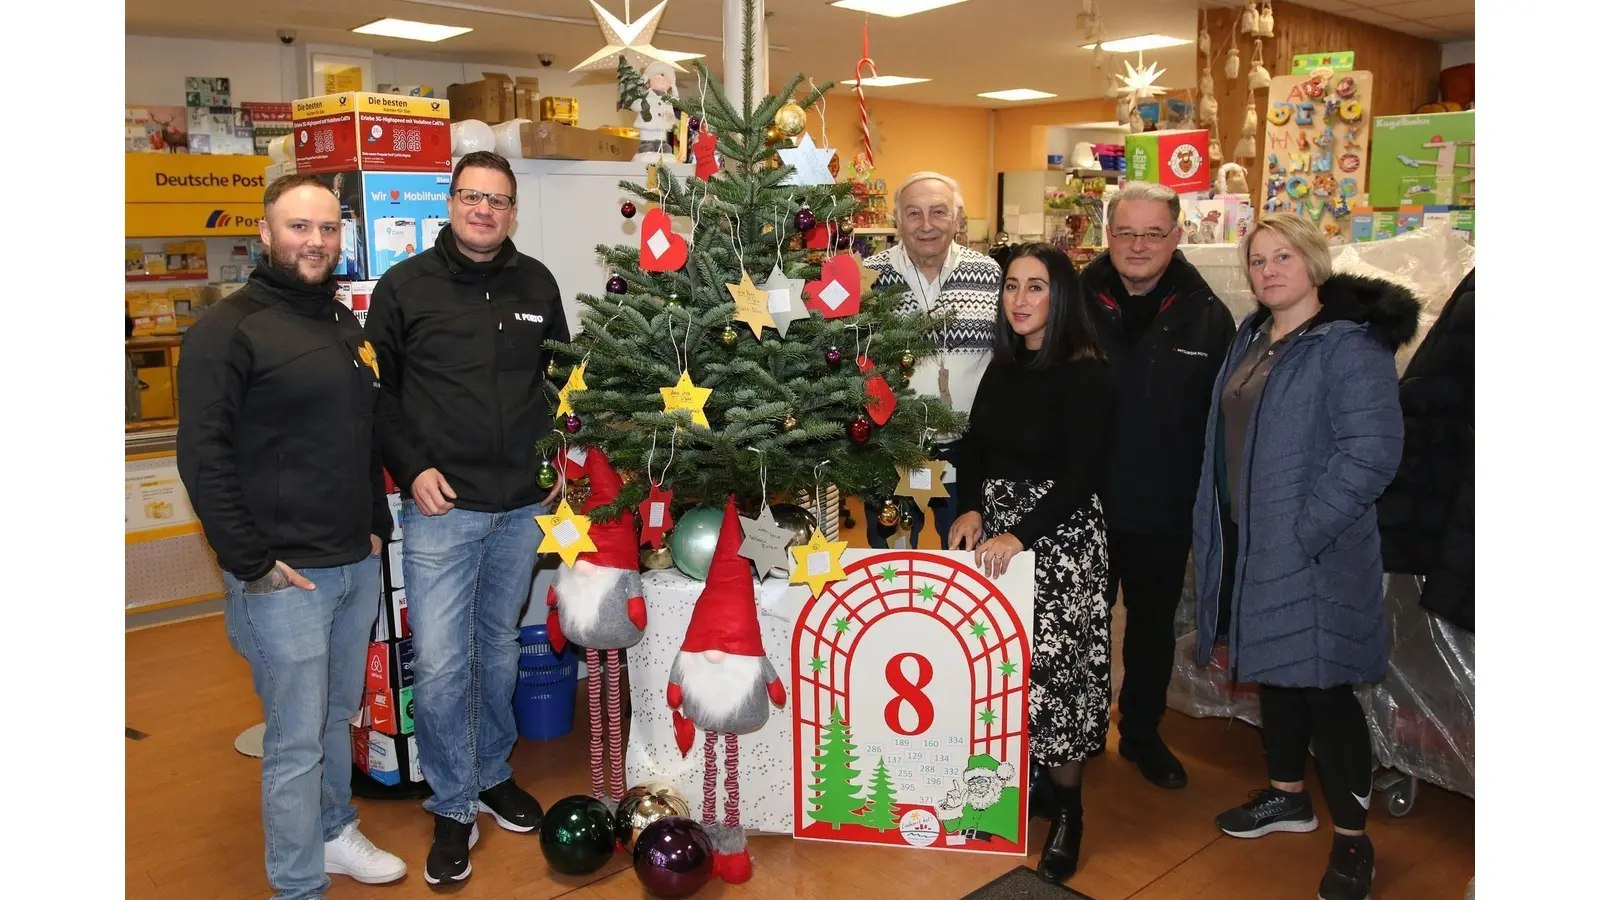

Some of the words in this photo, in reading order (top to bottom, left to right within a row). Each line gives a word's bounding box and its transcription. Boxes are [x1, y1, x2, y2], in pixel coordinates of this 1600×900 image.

[306, 102, 322, 110] besten
[368, 97, 381, 105] Die
[383, 98, 408, 107] besten
[1376, 117, 1430, 129] Kugelbahn
[393, 140, 407, 151] 20
[407, 140, 422, 152] GB
[155, 172, 229, 187] Deutsche
[232, 174, 265, 187] Post
[371, 191, 387, 201] Wir
[404, 191, 447, 201] Mobilfunk
[386, 227, 392, 235] 9
[884, 652, 935, 736] 8
[375, 694, 387, 704] NIKE
[924, 740, 939, 748] 160
[948, 736, 963, 744] 334
[867, 745, 882, 753] 286
[908, 752, 923, 760] 129
[935, 754, 949, 762] 134
[920, 765, 935, 773] 288
[898, 770, 913, 778] 255
[900, 783, 915, 791] 395
[919, 796, 933, 804] 371
